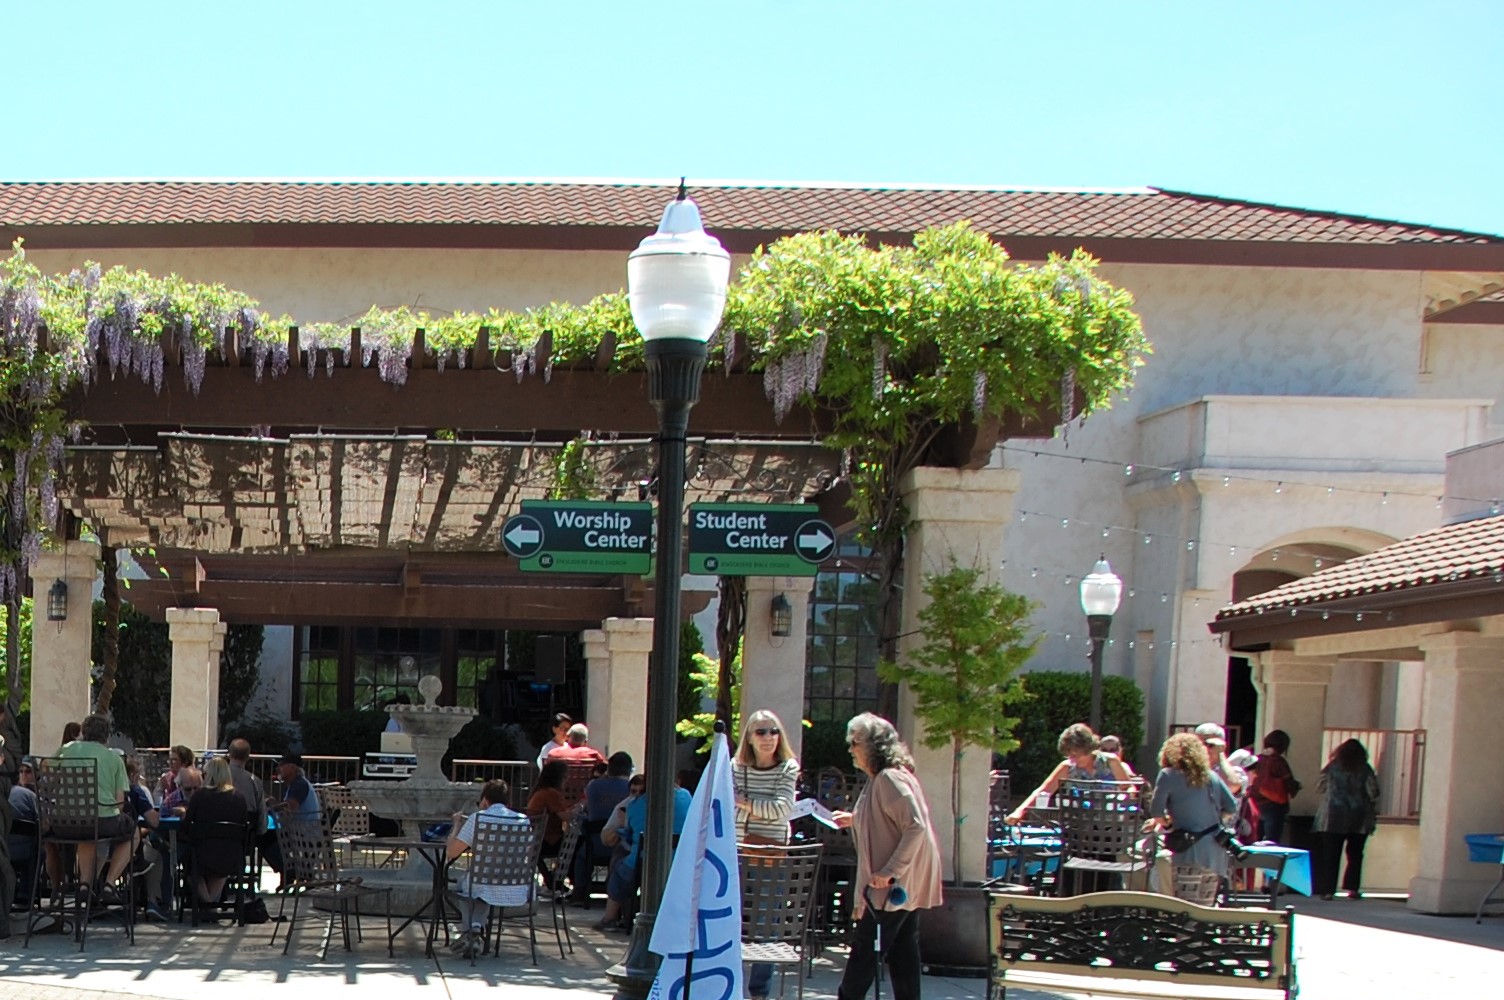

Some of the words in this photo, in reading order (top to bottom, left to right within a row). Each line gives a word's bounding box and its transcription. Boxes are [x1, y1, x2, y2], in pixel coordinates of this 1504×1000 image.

[553, 510, 632, 533] Worship
[695, 511, 767, 530] Student
[584, 531, 647, 549] Center
[726, 531, 788, 549] Center
